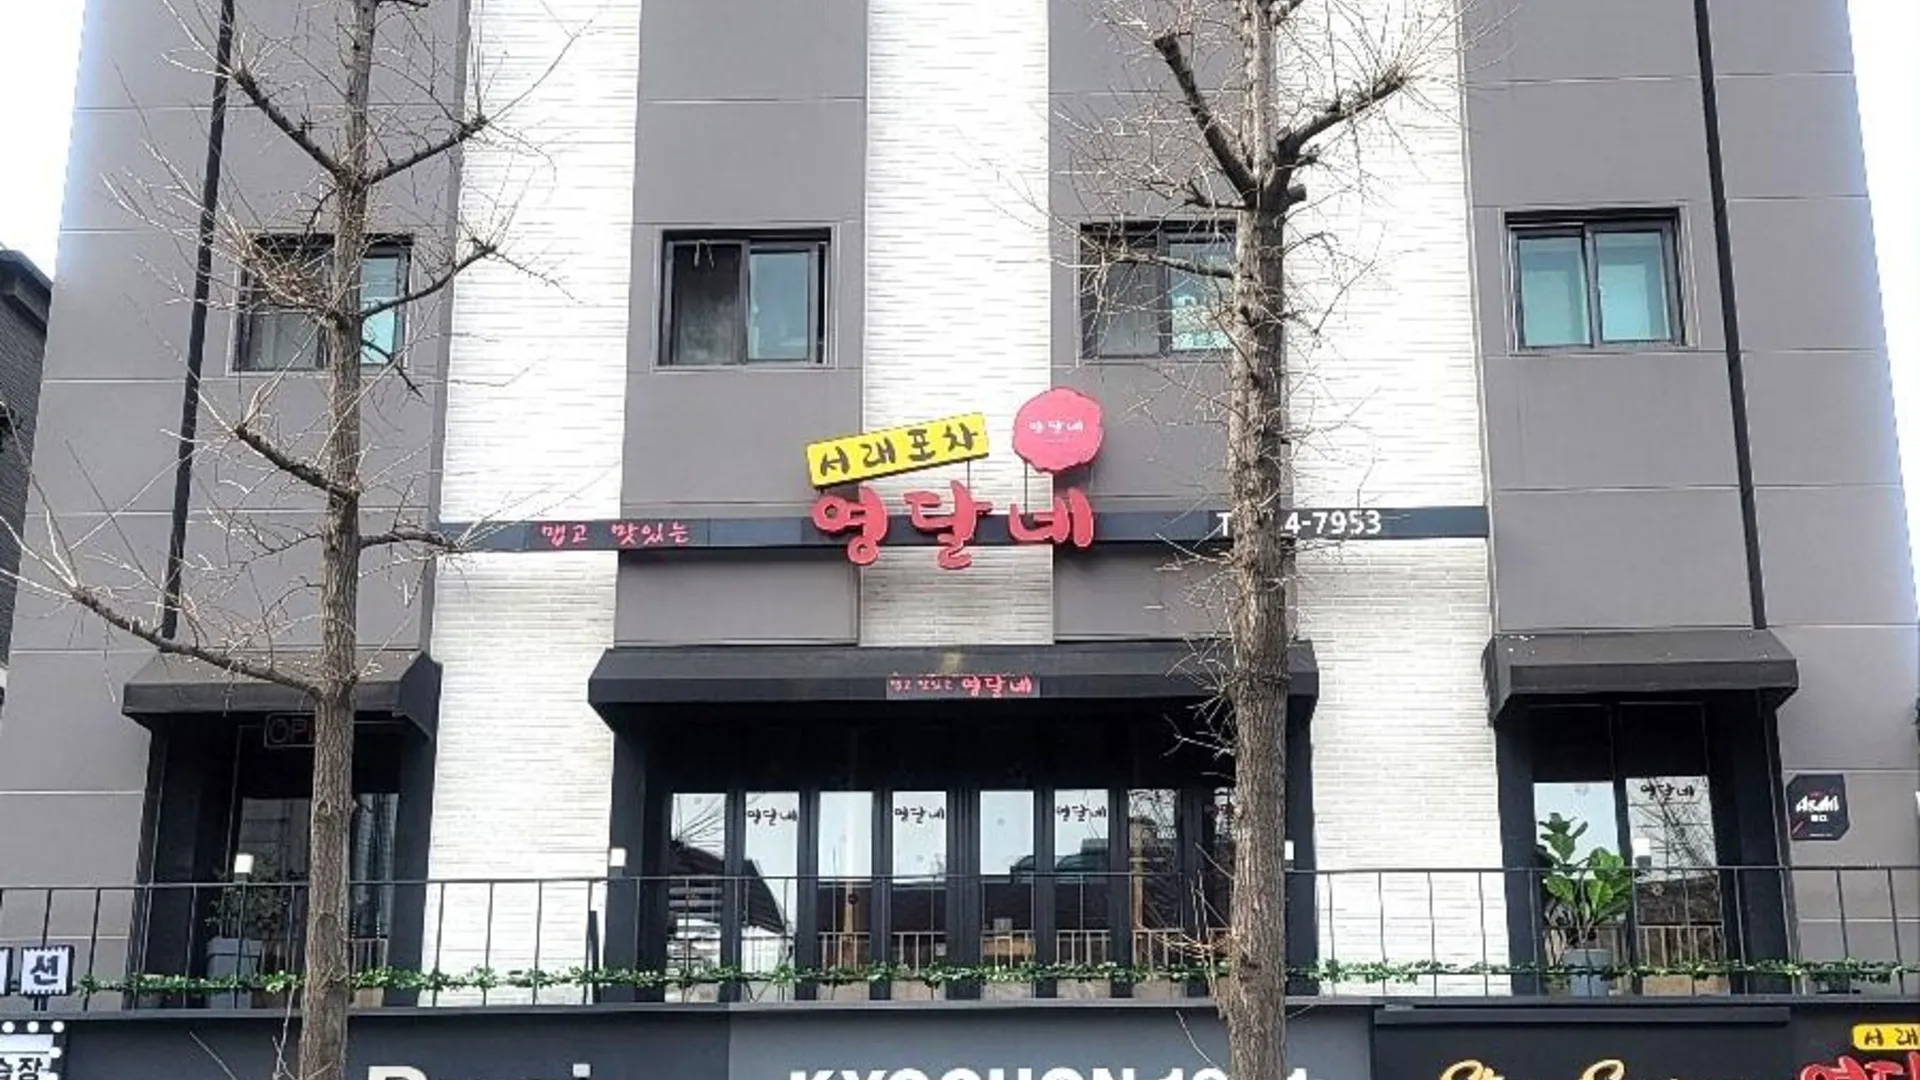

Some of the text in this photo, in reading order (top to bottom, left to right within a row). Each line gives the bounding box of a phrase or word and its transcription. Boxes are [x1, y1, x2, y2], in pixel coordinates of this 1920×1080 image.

[818, 421, 979, 477] 서래포차
[541, 521, 690, 547] 맵고 맛있는
[810, 479, 1094, 570] 영달네
[961, 675, 1033, 698] 영달네
[747, 807, 798, 826] 영달네
[895, 806, 945, 824] 영달네
[1056, 804, 1107, 822] 영달네
[30, 955, 59, 986] 션
